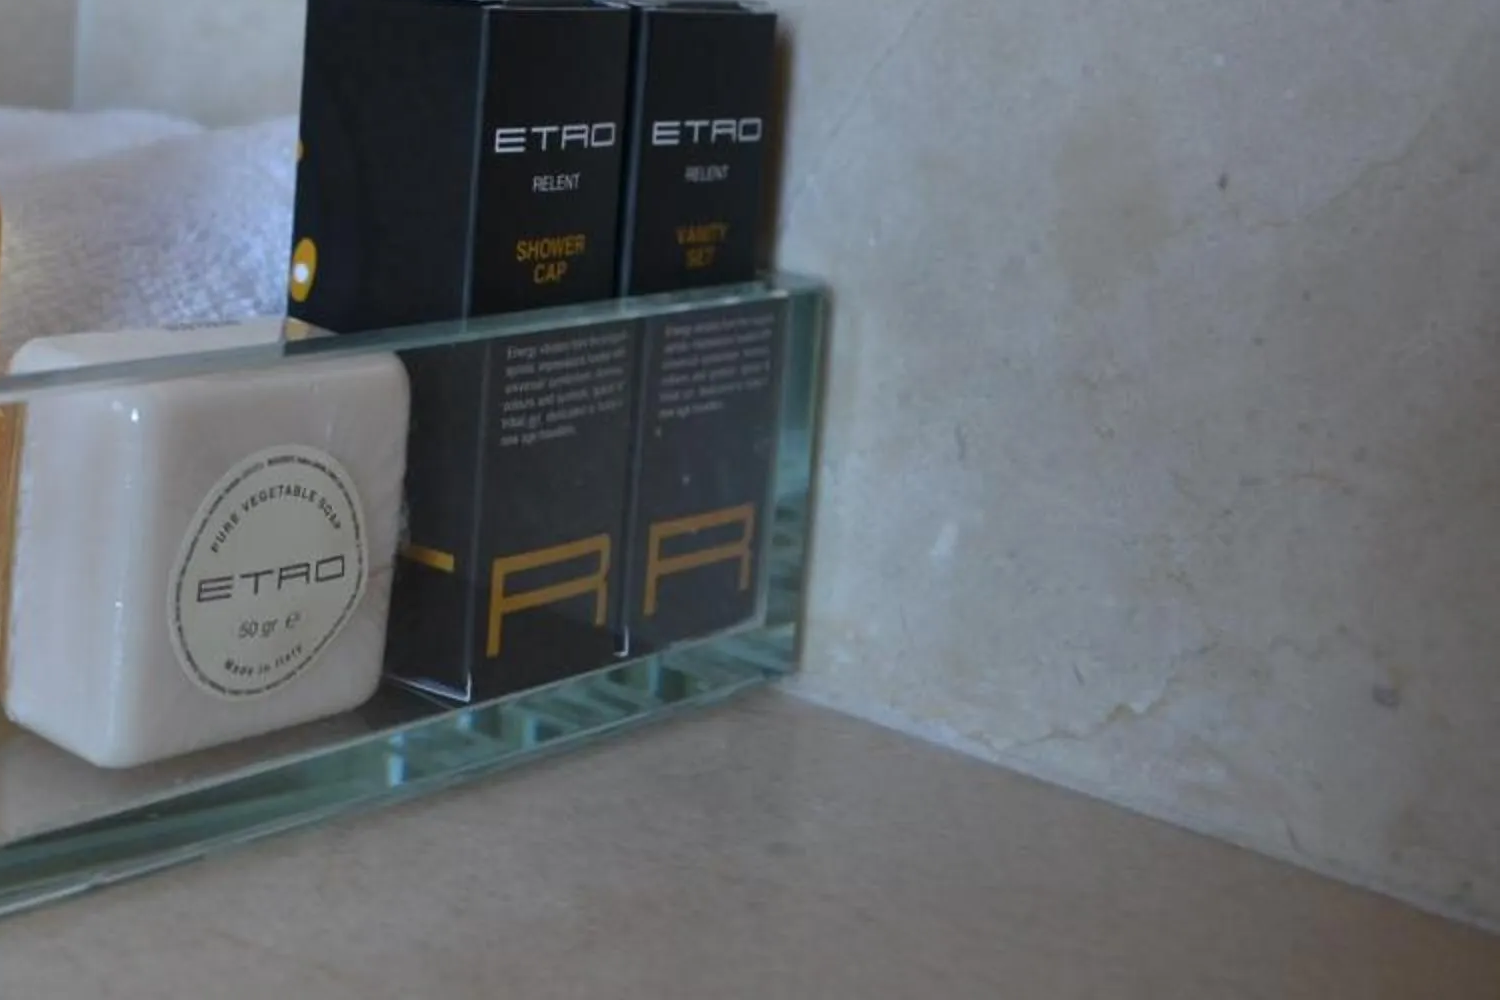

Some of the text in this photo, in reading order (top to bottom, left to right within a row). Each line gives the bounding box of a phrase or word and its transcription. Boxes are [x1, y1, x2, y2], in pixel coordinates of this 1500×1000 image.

[494, 121, 616, 154] ETRO
[651, 117, 763, 147] ETRO
[532, 171, 581, 193] RELENT
[684, 164, 730, 184] RELENT
[515, 233, 586, 263] SHOWER
[675, 222, 731, 246] VANITY
[532, 260, 569, 285] CAP
[209, 483, 342, 554] PURE VEGETABLE SOAP
[196, 554, 345, 602] ETRO
[238, 618, 259, 640] 50
[224, 658, 254, 677] Made
[275, 643, 303, 668] Italy
